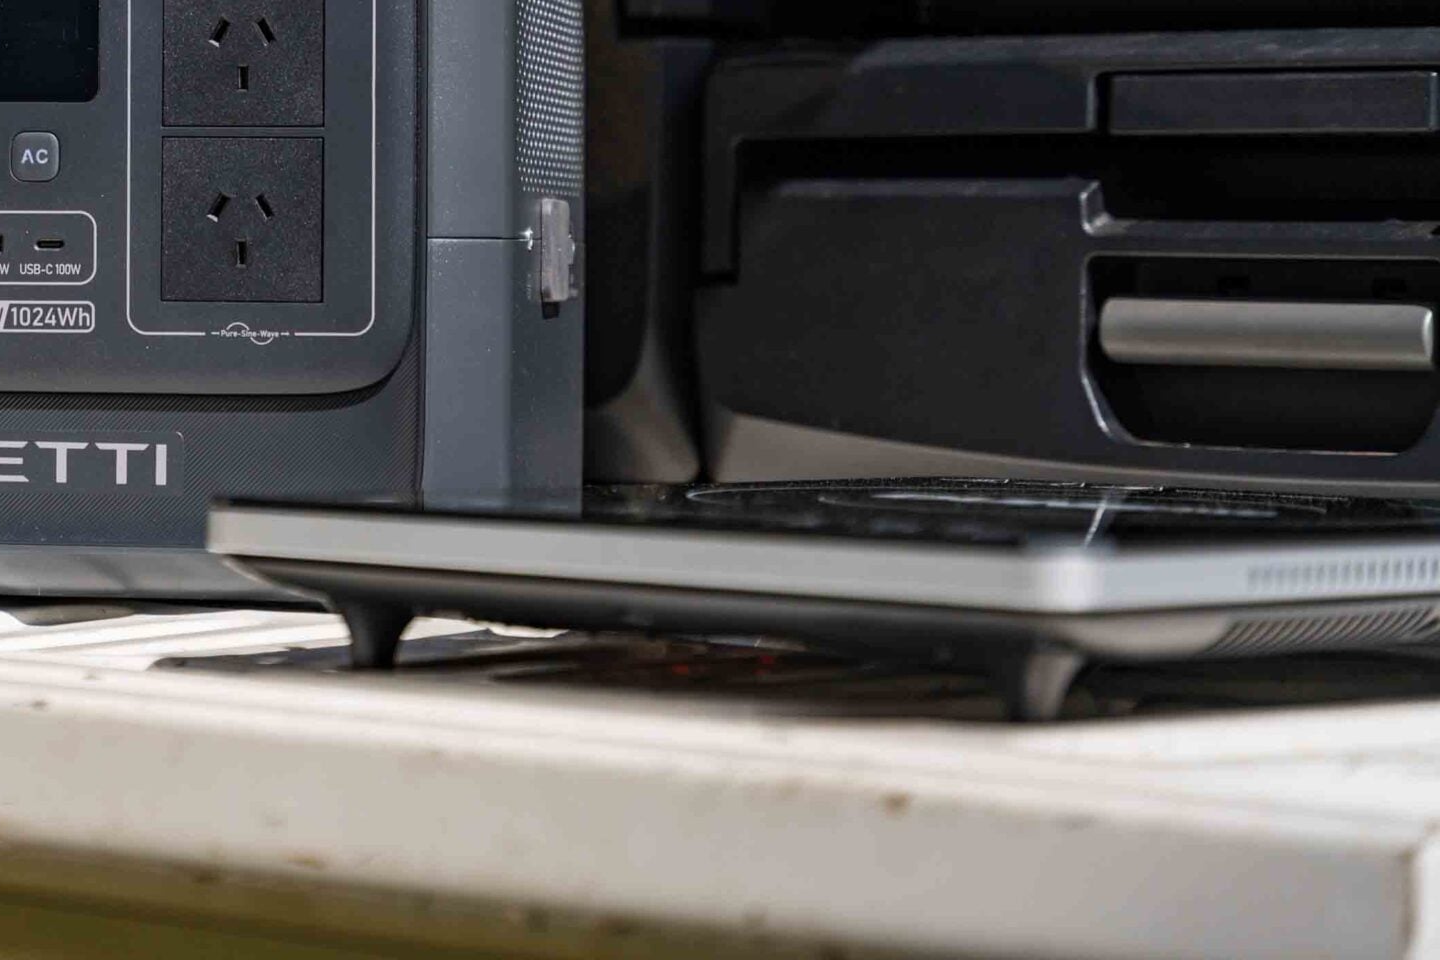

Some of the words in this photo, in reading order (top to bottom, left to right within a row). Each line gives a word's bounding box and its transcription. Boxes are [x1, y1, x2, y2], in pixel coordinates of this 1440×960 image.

[20, 149, 49, 165] AC
[19, 263, 53, 276] USB-C
[55, 263, 81, 276] 100W
